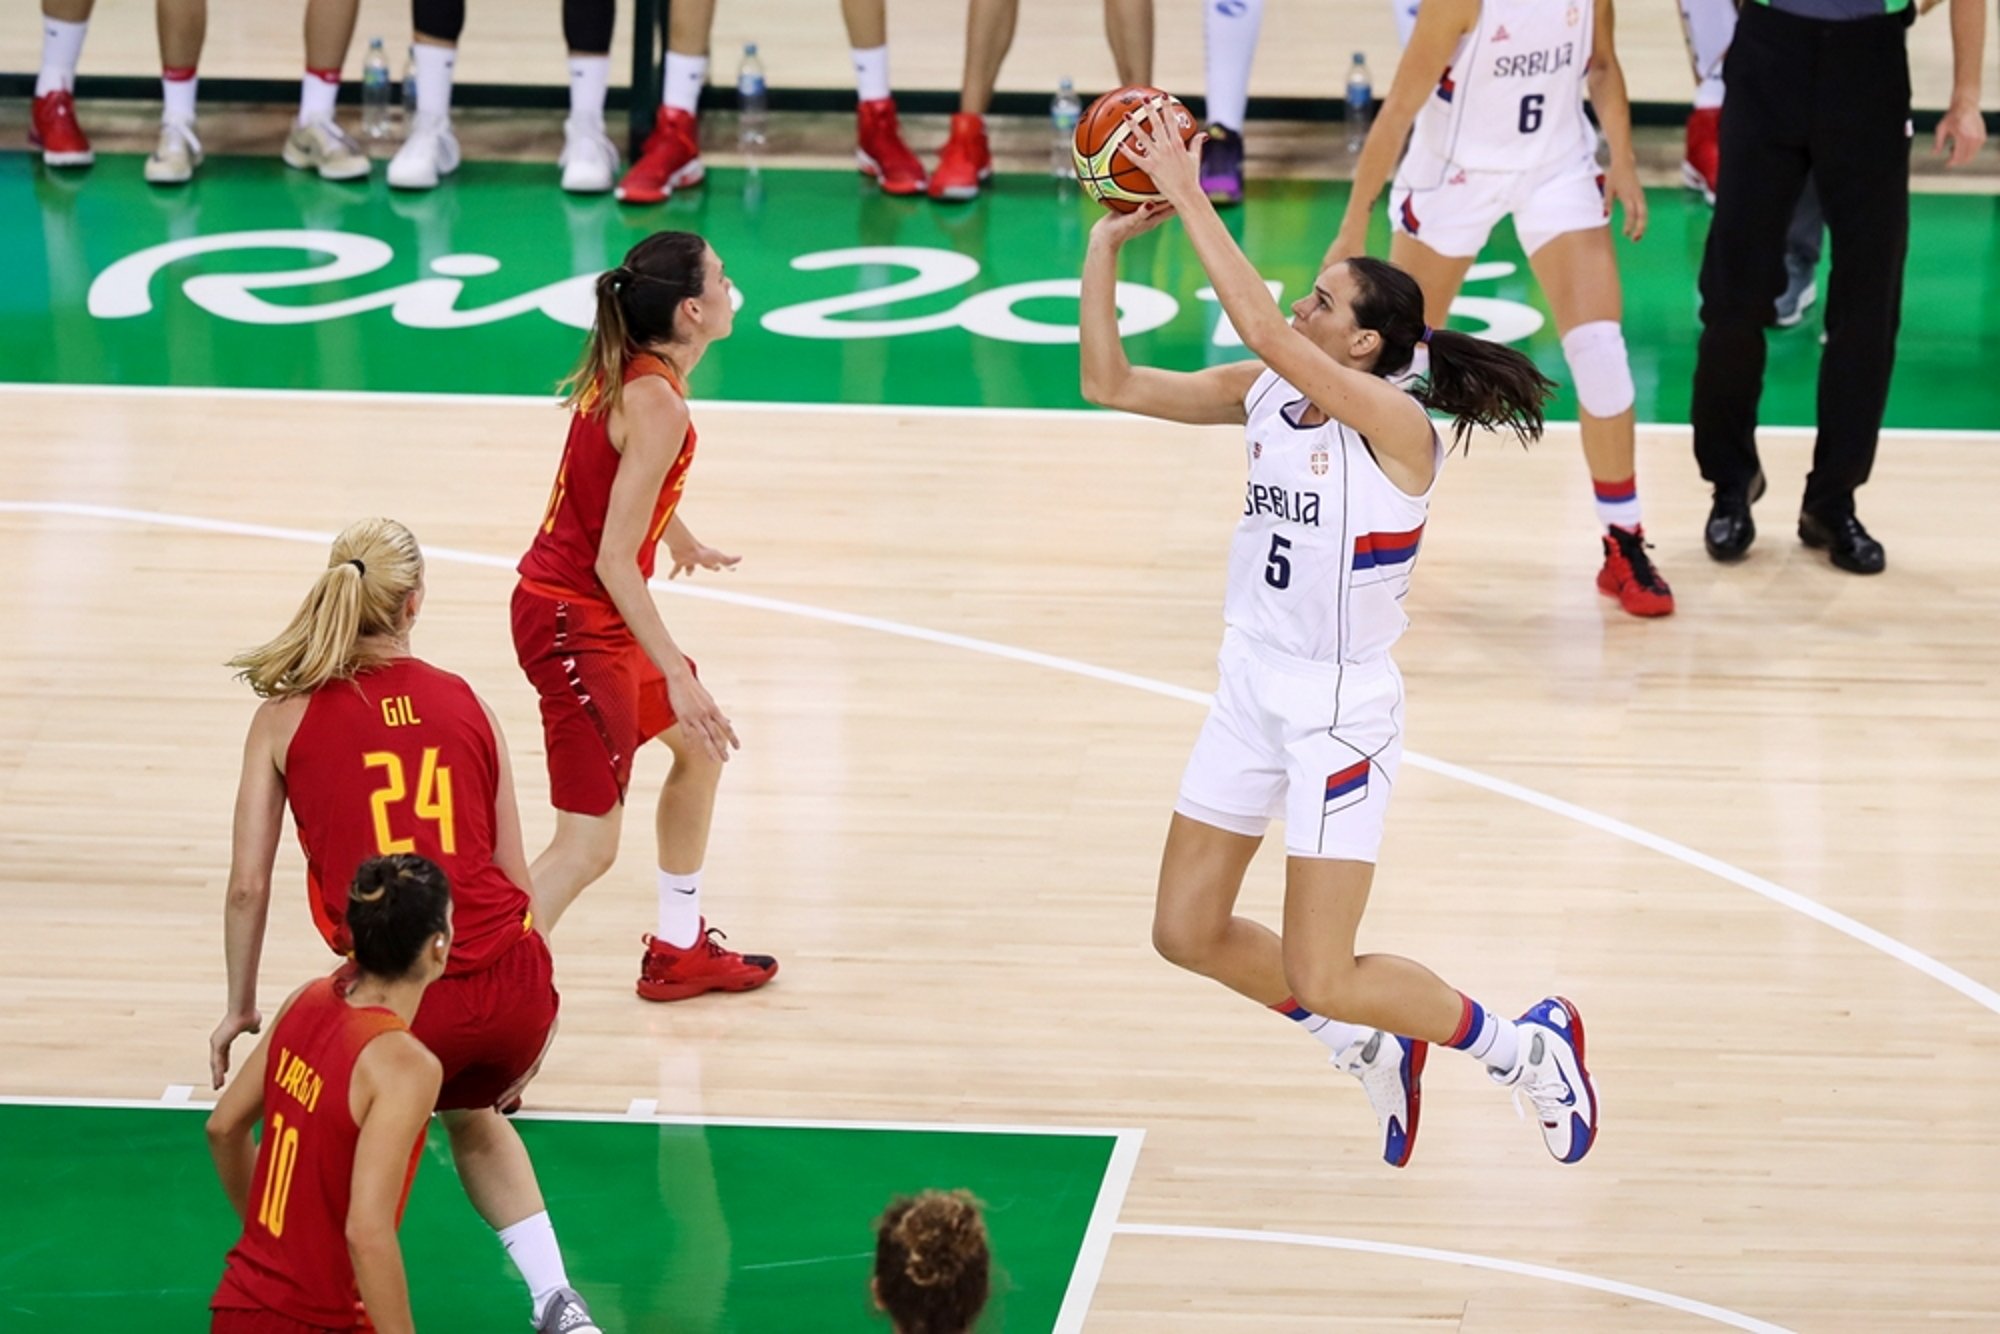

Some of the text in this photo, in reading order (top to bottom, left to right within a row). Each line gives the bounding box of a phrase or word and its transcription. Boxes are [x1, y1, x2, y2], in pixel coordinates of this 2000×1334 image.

[1518, 93, 1545, 134] 6
[1265, 533, 1292, 590] 5
[381, 695, 421, 727] GIL
[362, 747, 456, 856] 24
[258, 1112, 298, 1238] 10
